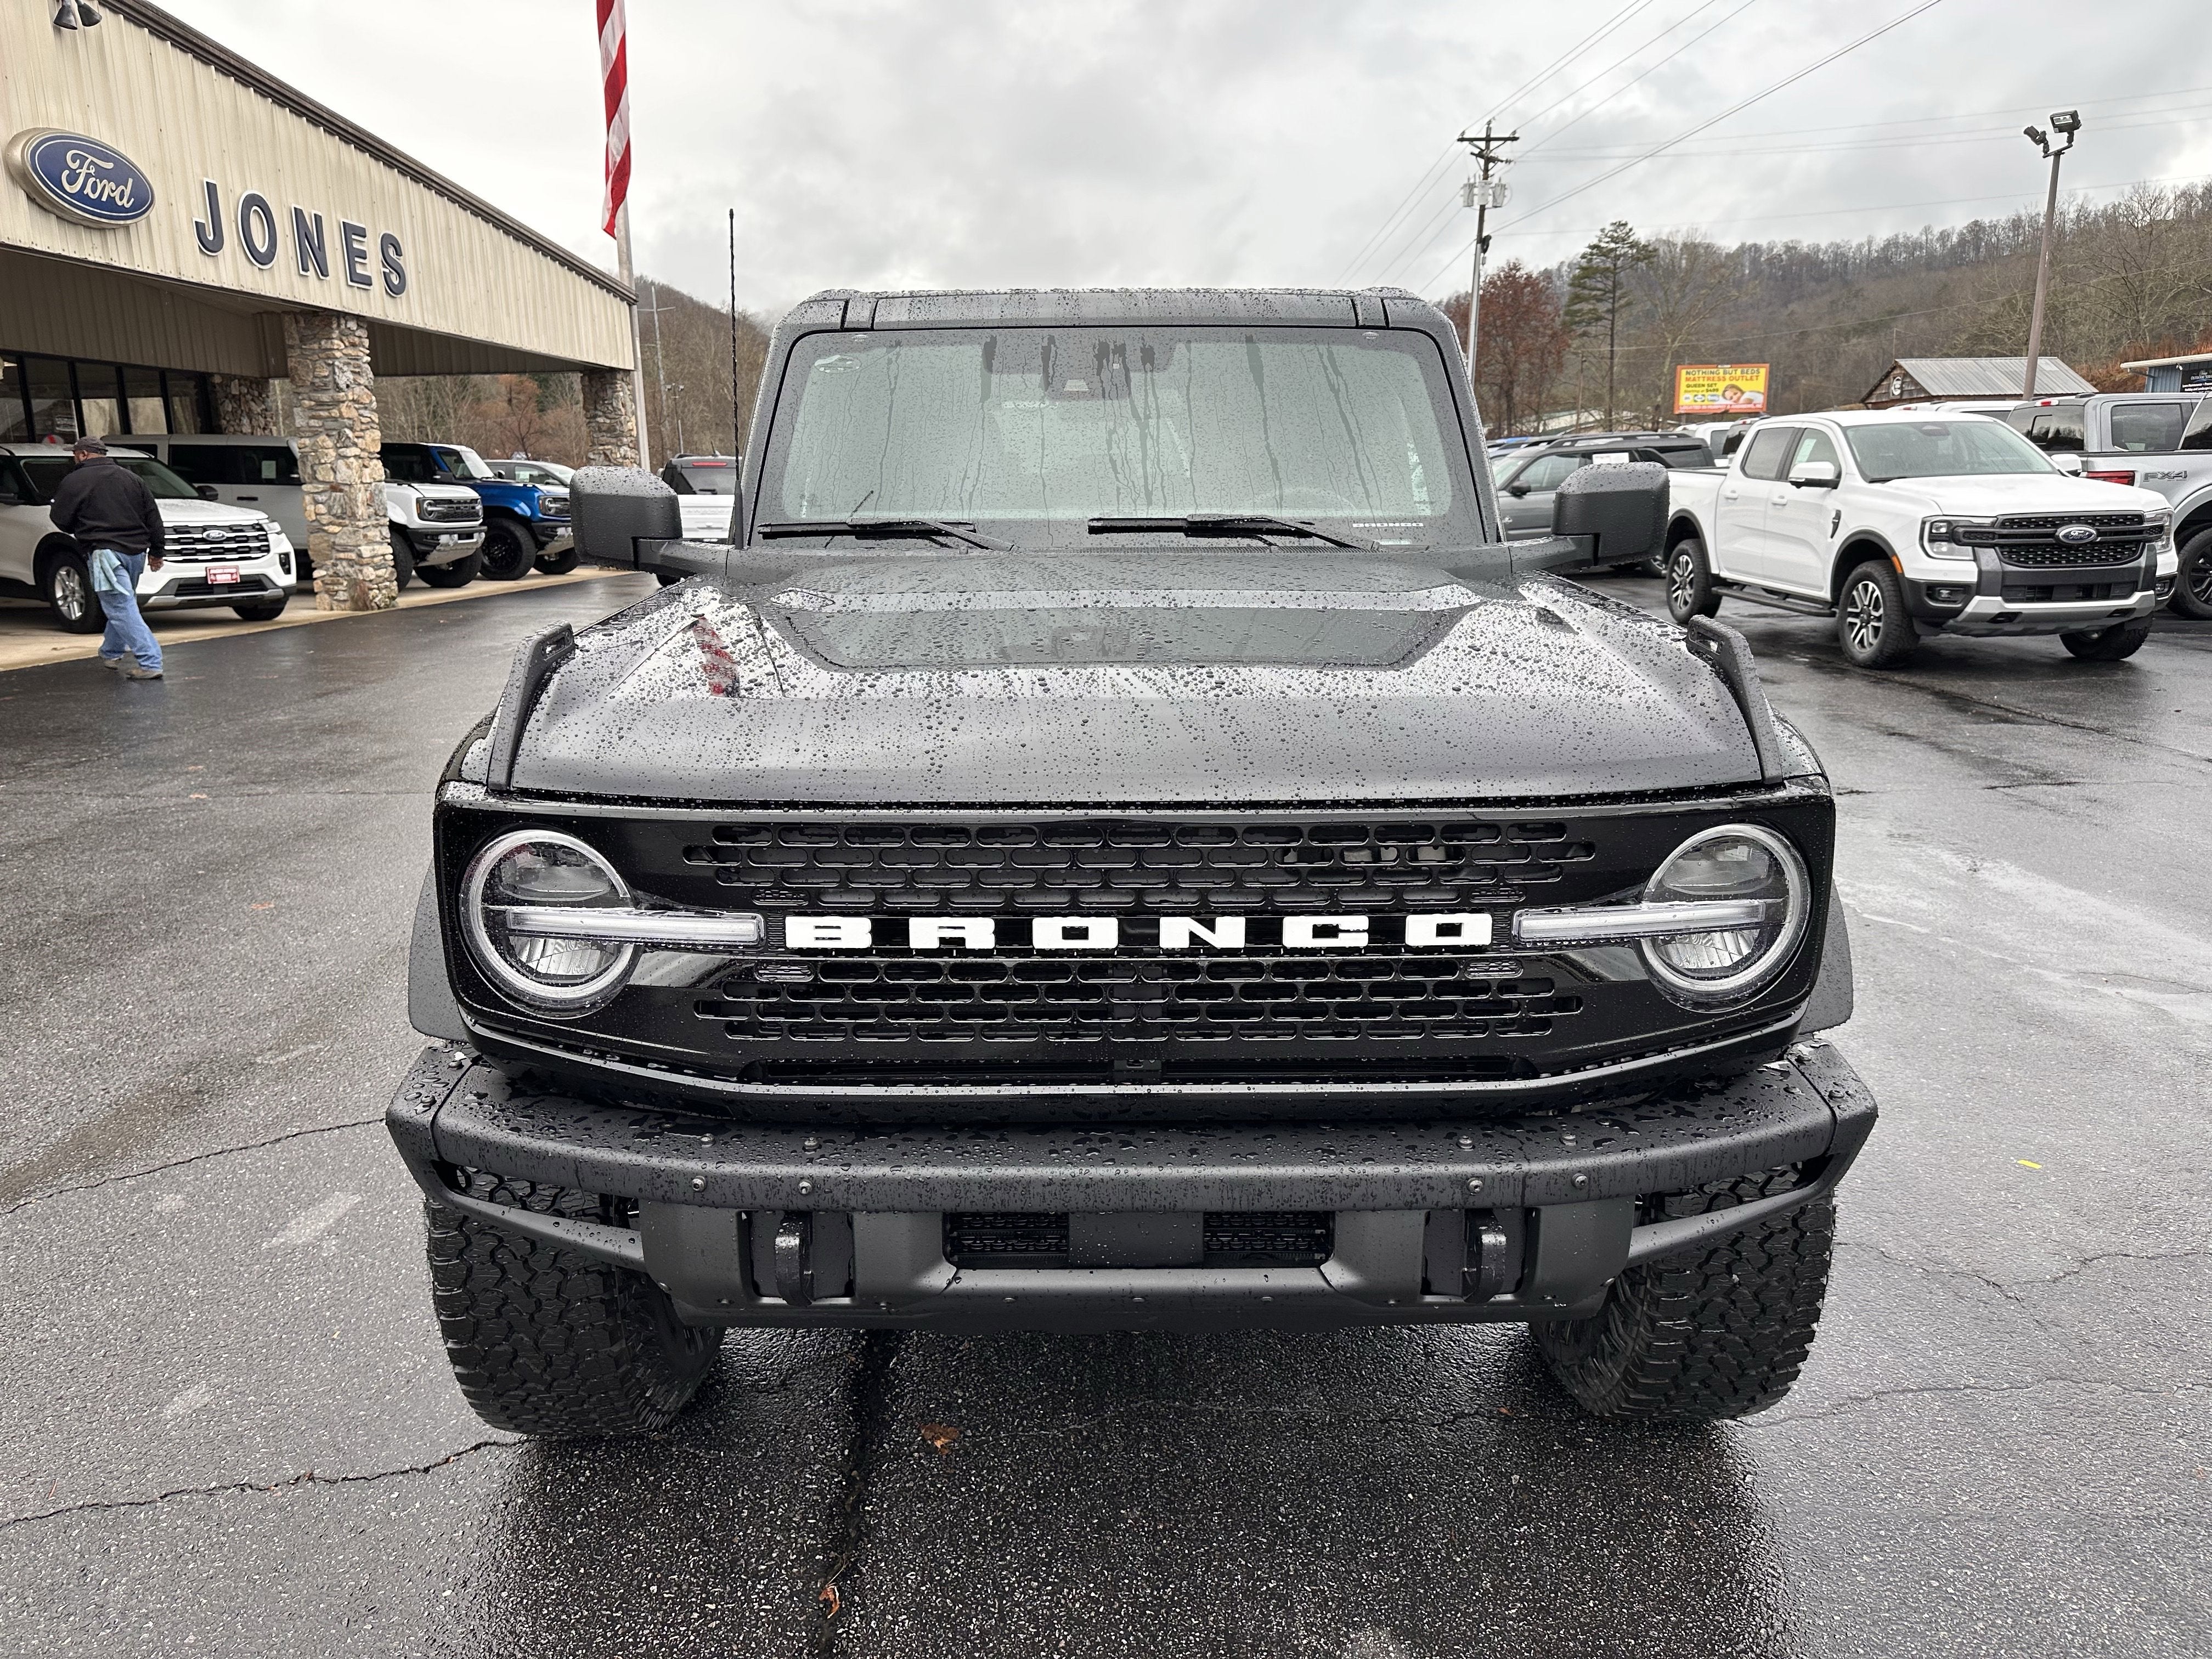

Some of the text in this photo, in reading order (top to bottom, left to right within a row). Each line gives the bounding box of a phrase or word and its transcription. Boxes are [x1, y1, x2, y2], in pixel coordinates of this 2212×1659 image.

[61, 149, 134, 208] Ford
[193, 178, 407, 297] JONES
[2143, 471, 2188, 482] FX4
[2068, 530, 2089, 539] Ford
[785, 913, 1493, 949] BRONCO
